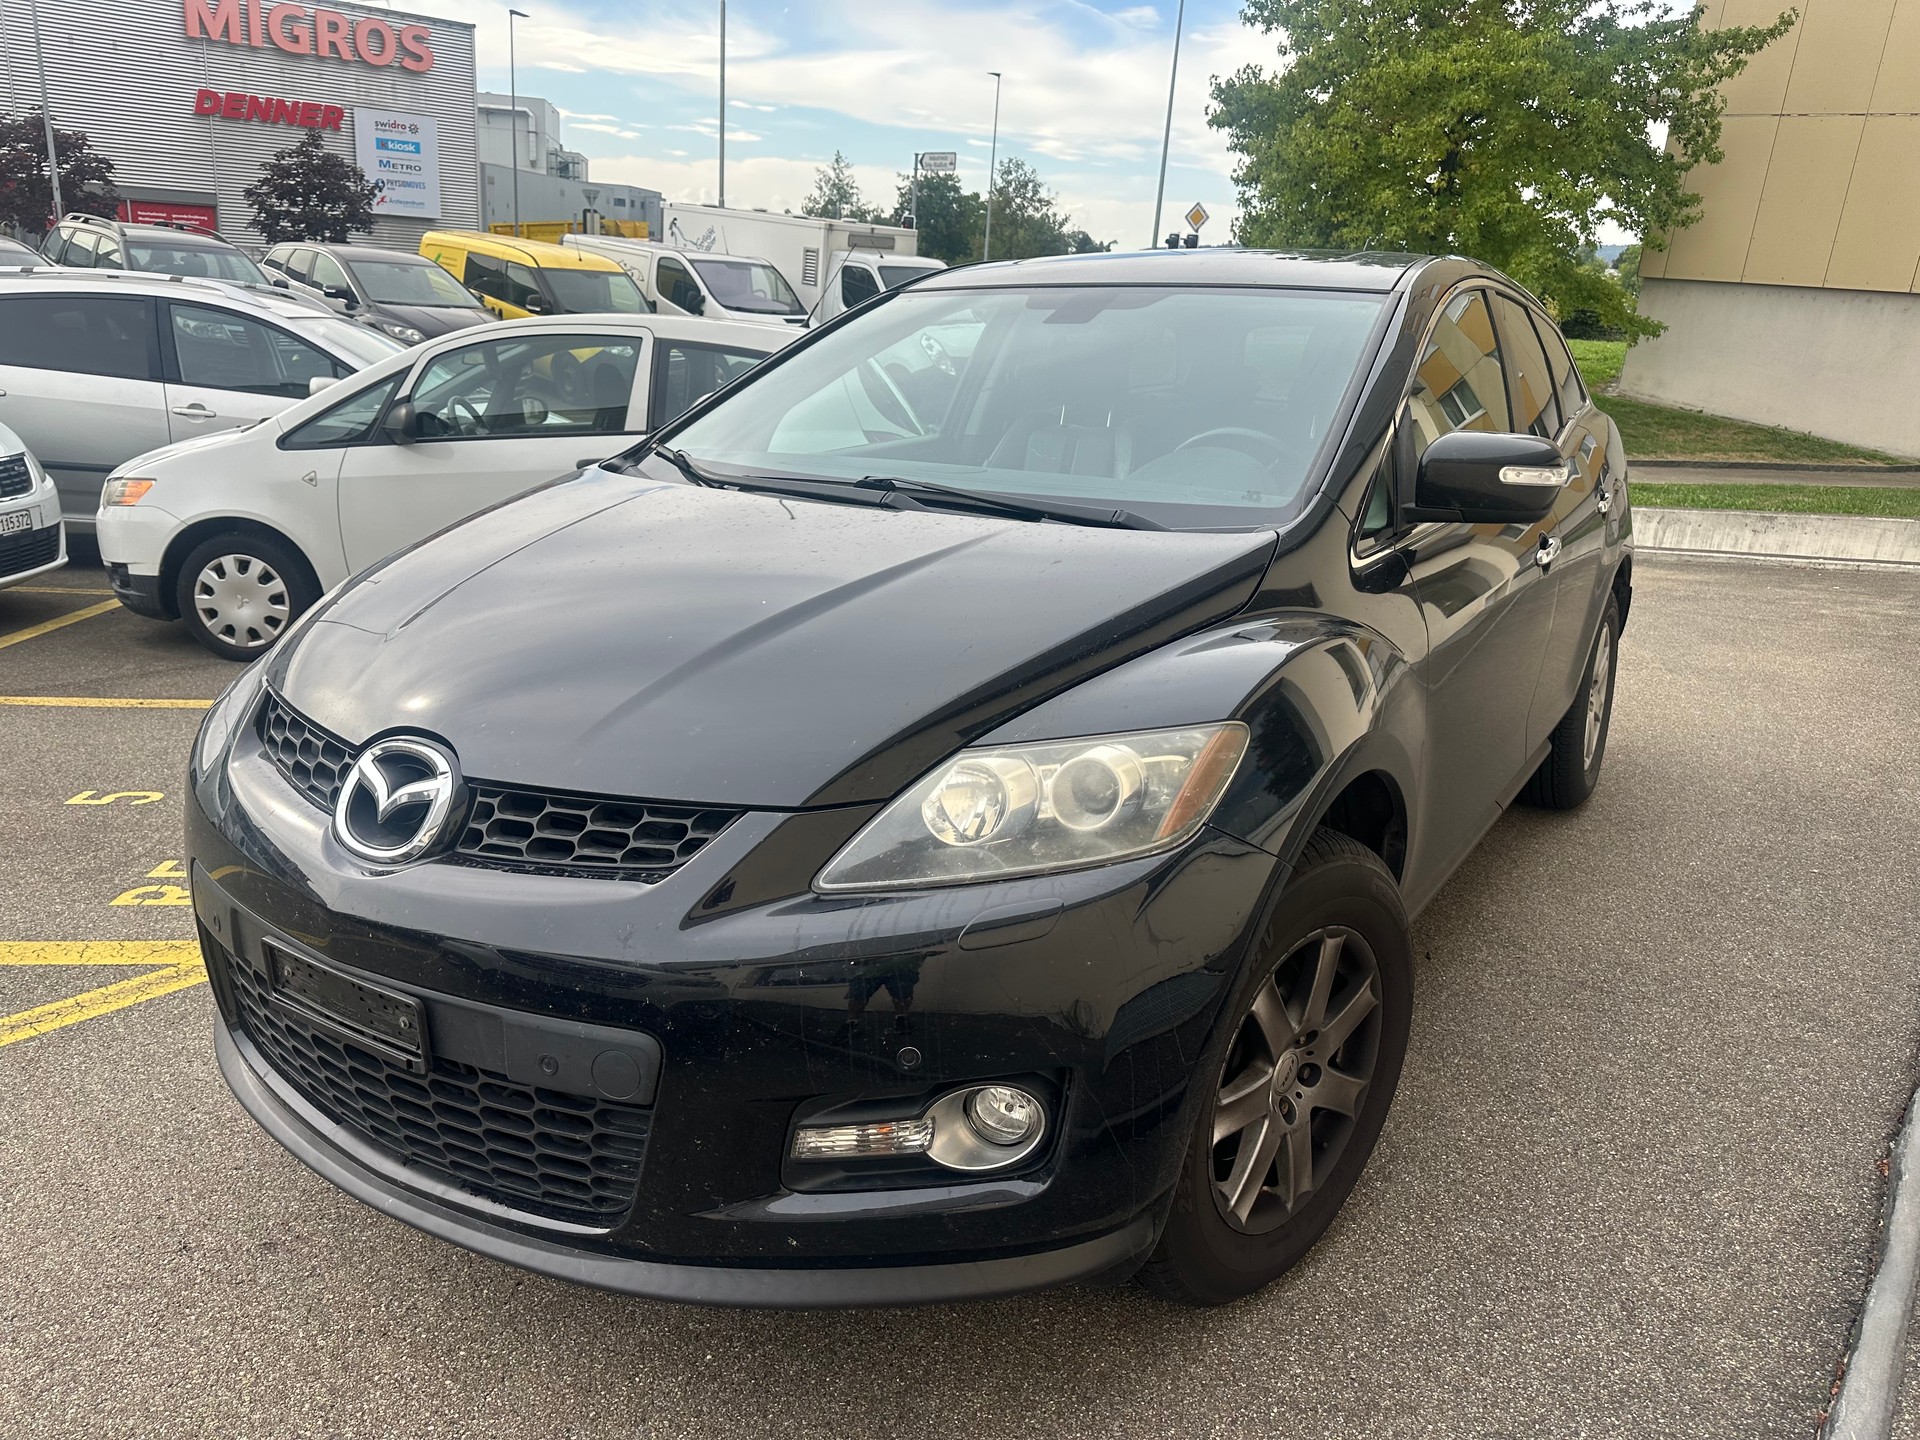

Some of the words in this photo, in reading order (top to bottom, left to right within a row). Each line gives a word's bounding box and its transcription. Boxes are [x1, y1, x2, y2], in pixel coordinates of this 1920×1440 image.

[183, 0, 434, 73] MIGROS
[193, 88, 344, 131] DENNER
[374, 119, 407, 131] swidro
[388, 141, 416, 152] kiosk
